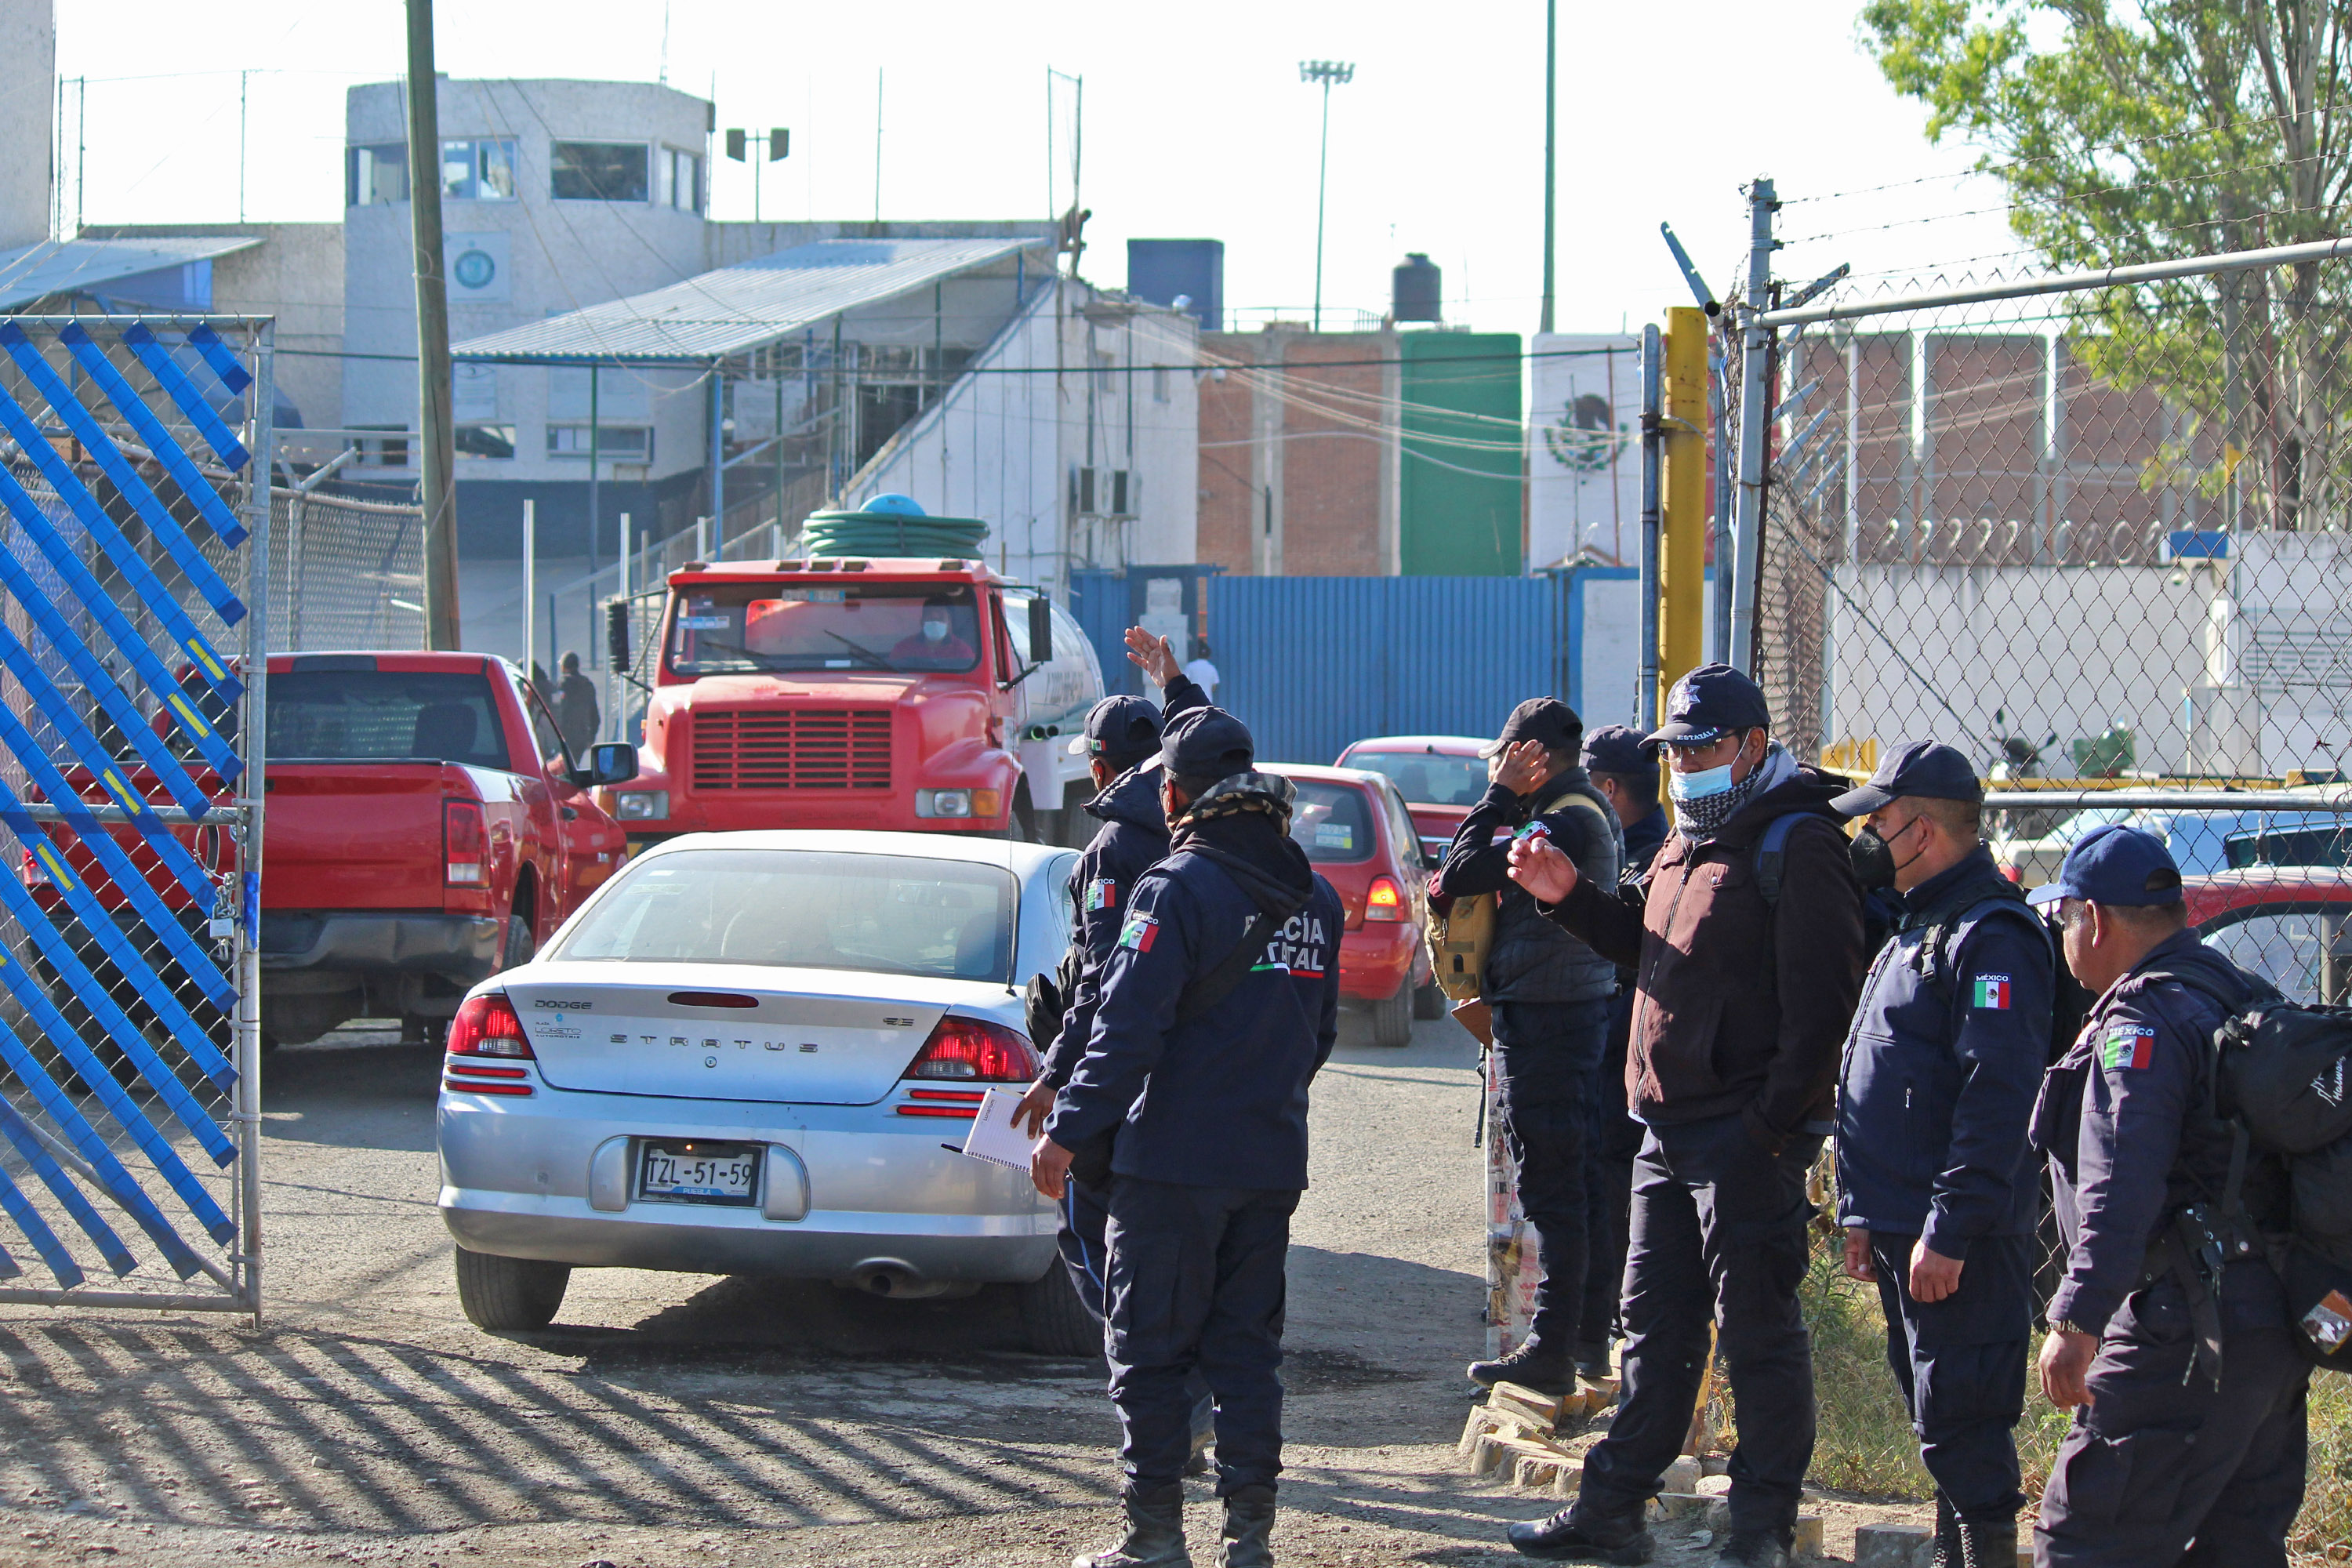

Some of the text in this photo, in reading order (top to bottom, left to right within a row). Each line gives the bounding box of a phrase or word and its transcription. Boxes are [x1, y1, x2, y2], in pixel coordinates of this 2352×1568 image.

[1676, 731, 1714, 741] ESTATAL
[1976, 973, 2009, 982] MÉXICO
[535, 1000, 593, 1010] DODGE
[610, 1034, 818, 1053] STRATUS
[648, 1157, 753, 1186] TZL-51-59
